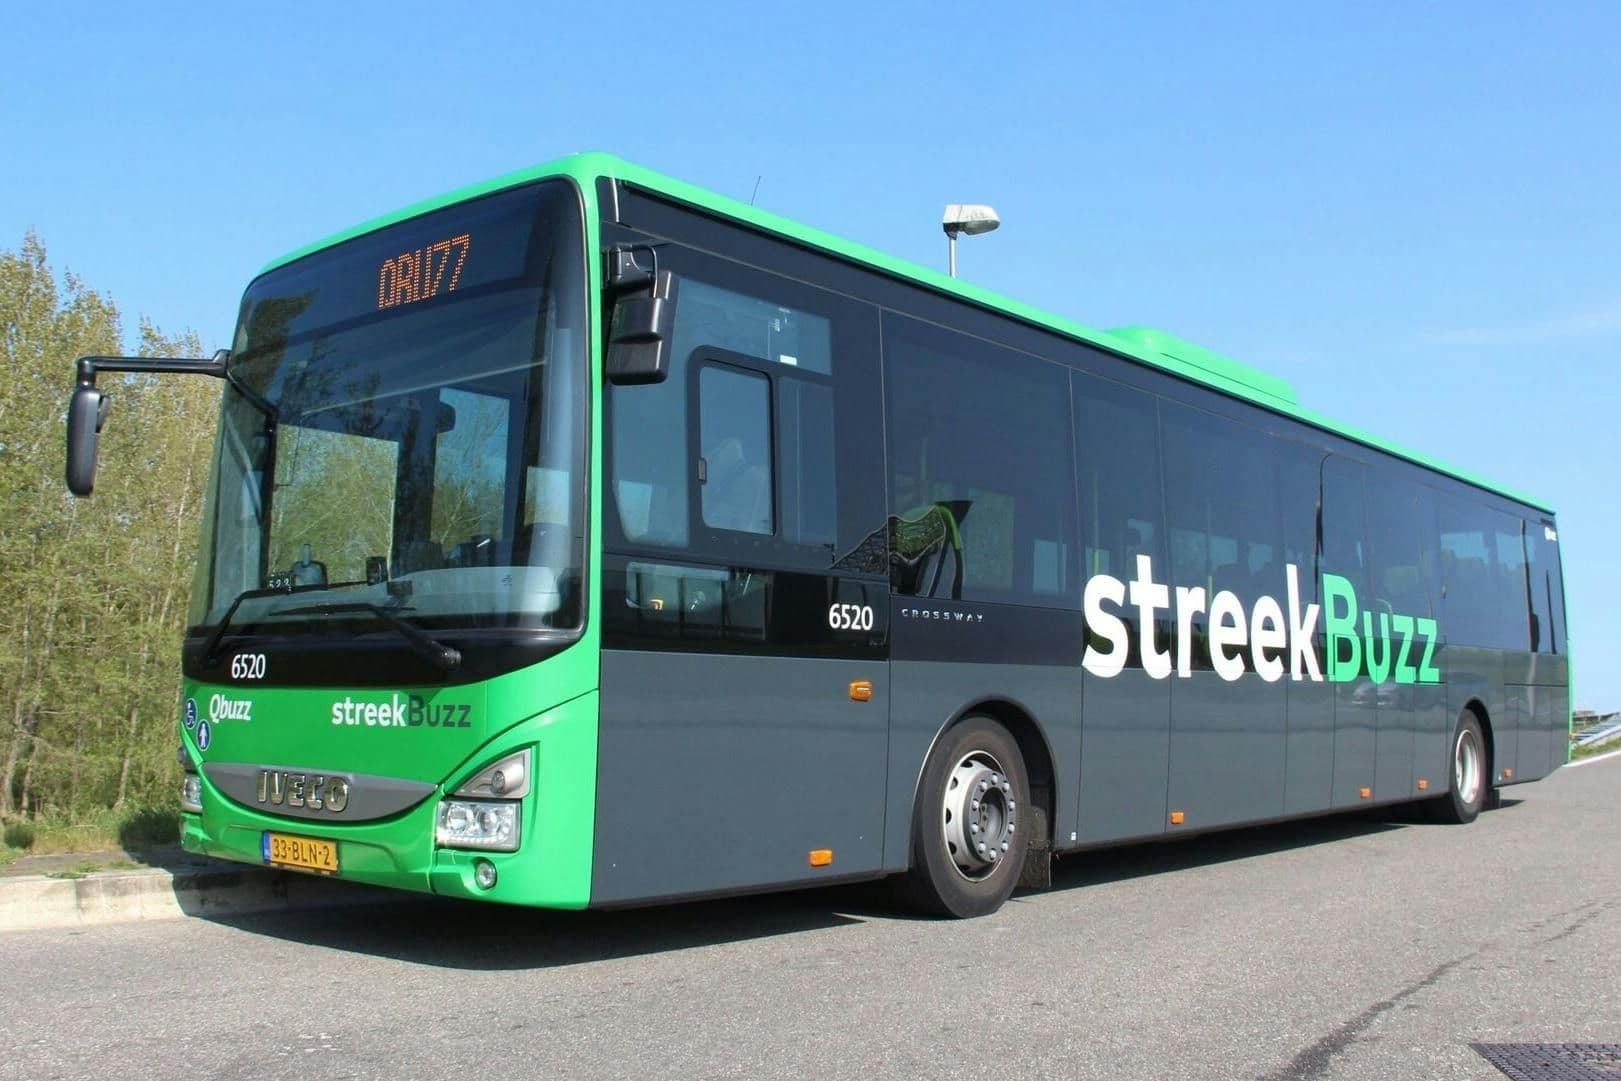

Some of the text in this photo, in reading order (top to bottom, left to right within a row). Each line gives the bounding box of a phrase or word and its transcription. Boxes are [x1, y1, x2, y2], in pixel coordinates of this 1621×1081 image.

[828, 603, 875, 631] 6520
[901, 608, 984, 623] CROSSWAY
[1081, 553, 1441, 685] streekBuzz
[231, 653, 267, 680] 6520
[209, 693, 252, 724] Qbuzz
[331, 693, 472, 728] streekBuzz
[257, 769, 350, 812] IVECO
[273, 838, 331, 867] 33-BLN-2
